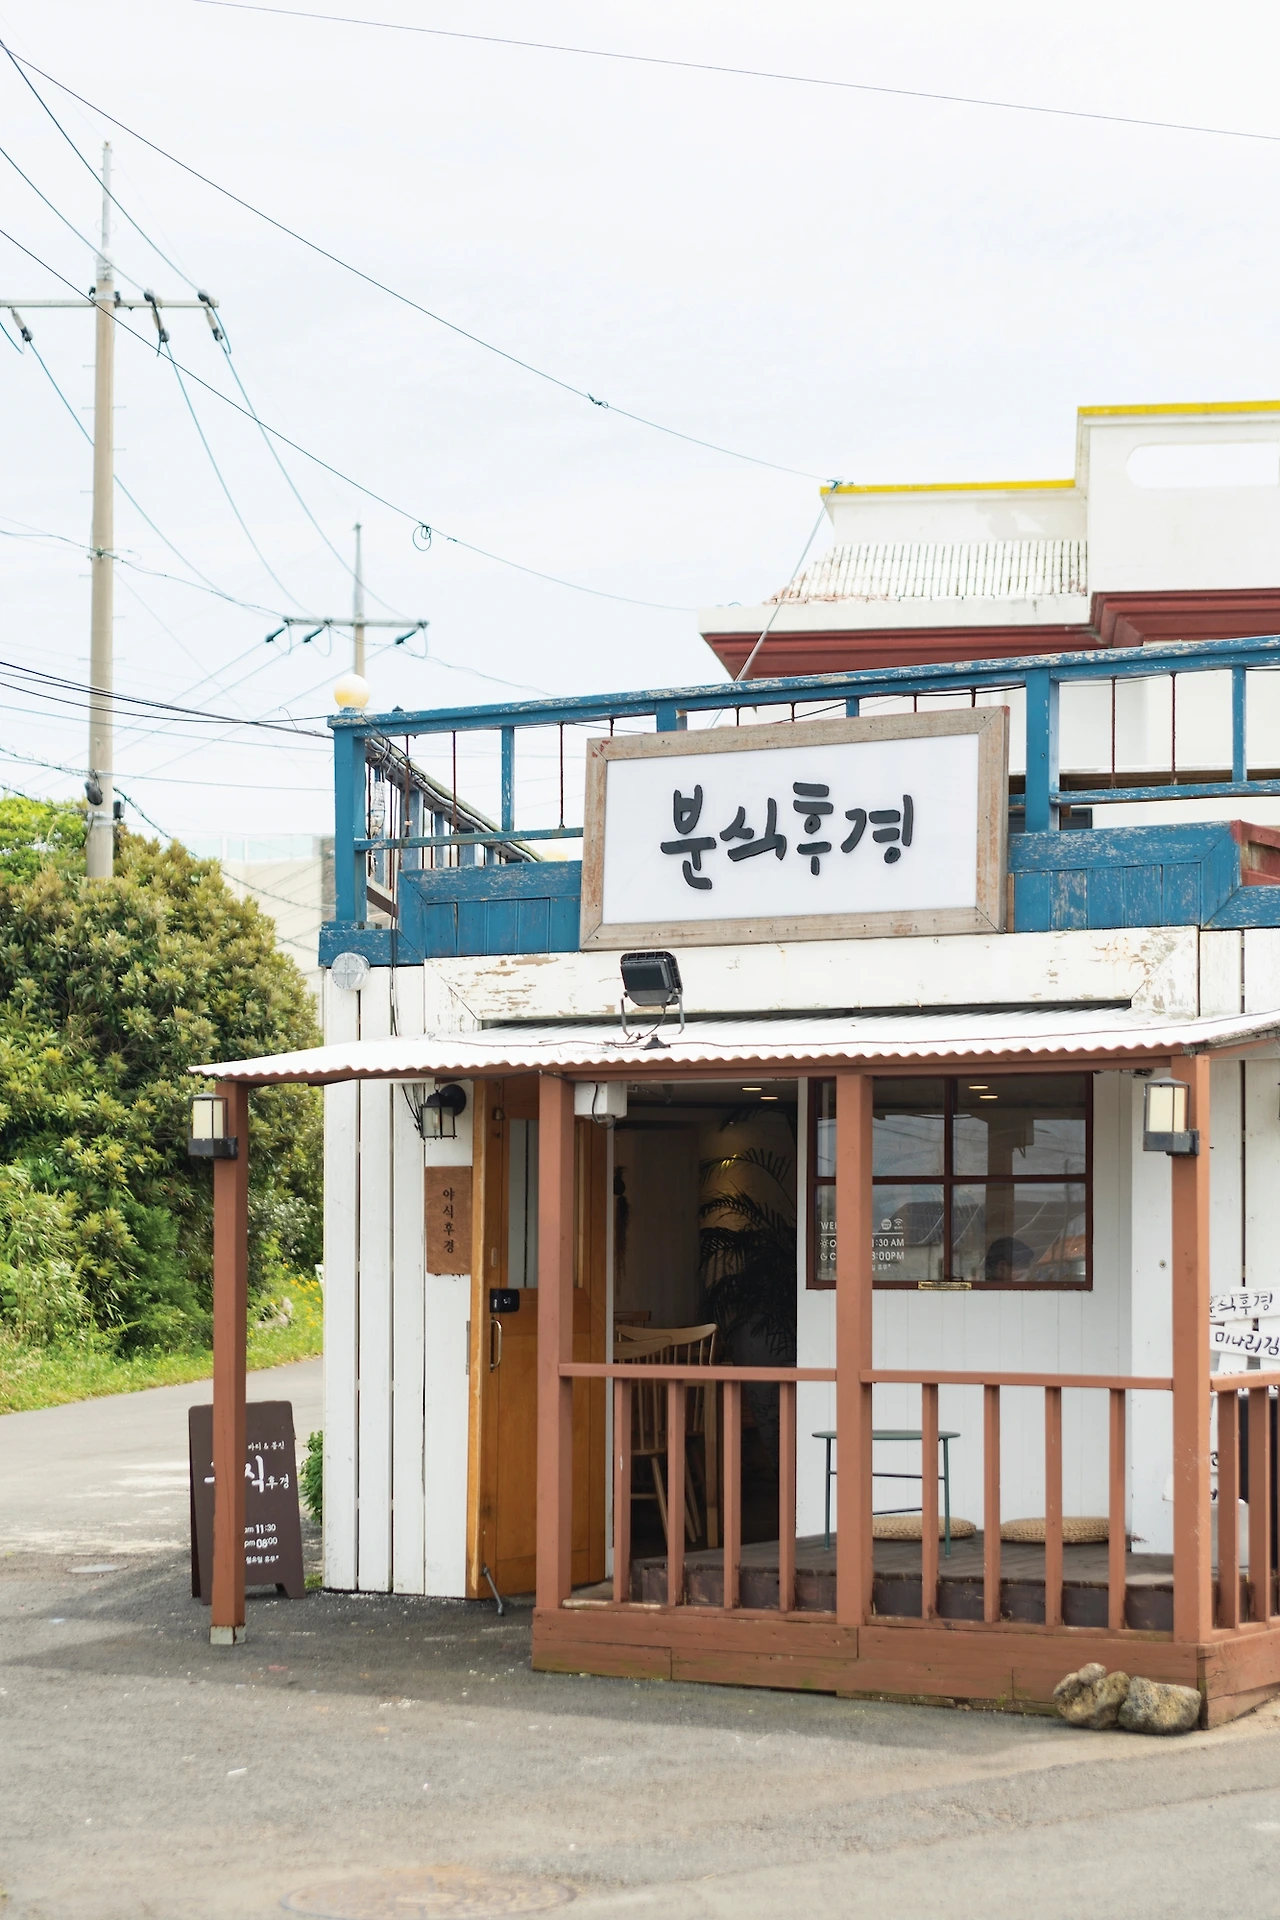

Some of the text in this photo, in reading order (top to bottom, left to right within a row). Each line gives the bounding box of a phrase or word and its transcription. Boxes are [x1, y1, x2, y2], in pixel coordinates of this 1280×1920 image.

[660, 781, 914, 890] 분식후경
[442, 1187, 455, 1254] 야식후경
[890, 1238, 905, 1247] AM
